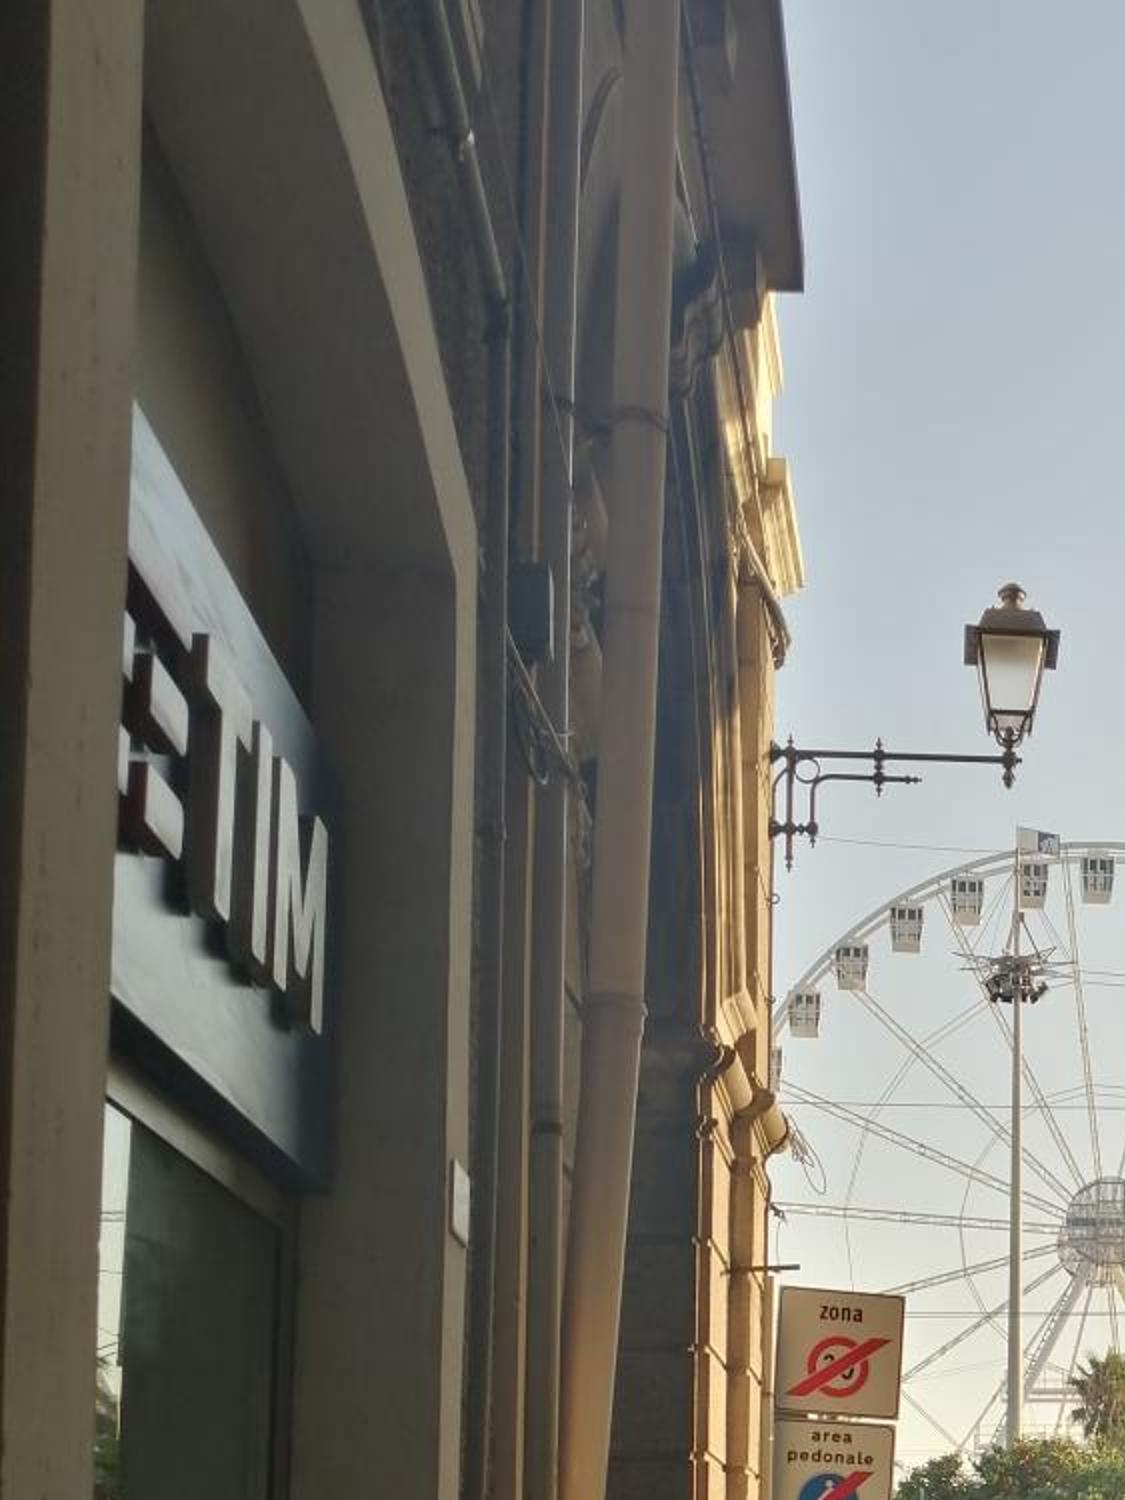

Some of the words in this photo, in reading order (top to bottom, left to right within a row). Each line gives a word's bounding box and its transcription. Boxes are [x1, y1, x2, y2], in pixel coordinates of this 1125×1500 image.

[819, 1304, 864, 1323] zona
[811, 1430, 853, 1444] area
[787, 1449, 874, 1466] pedonale
